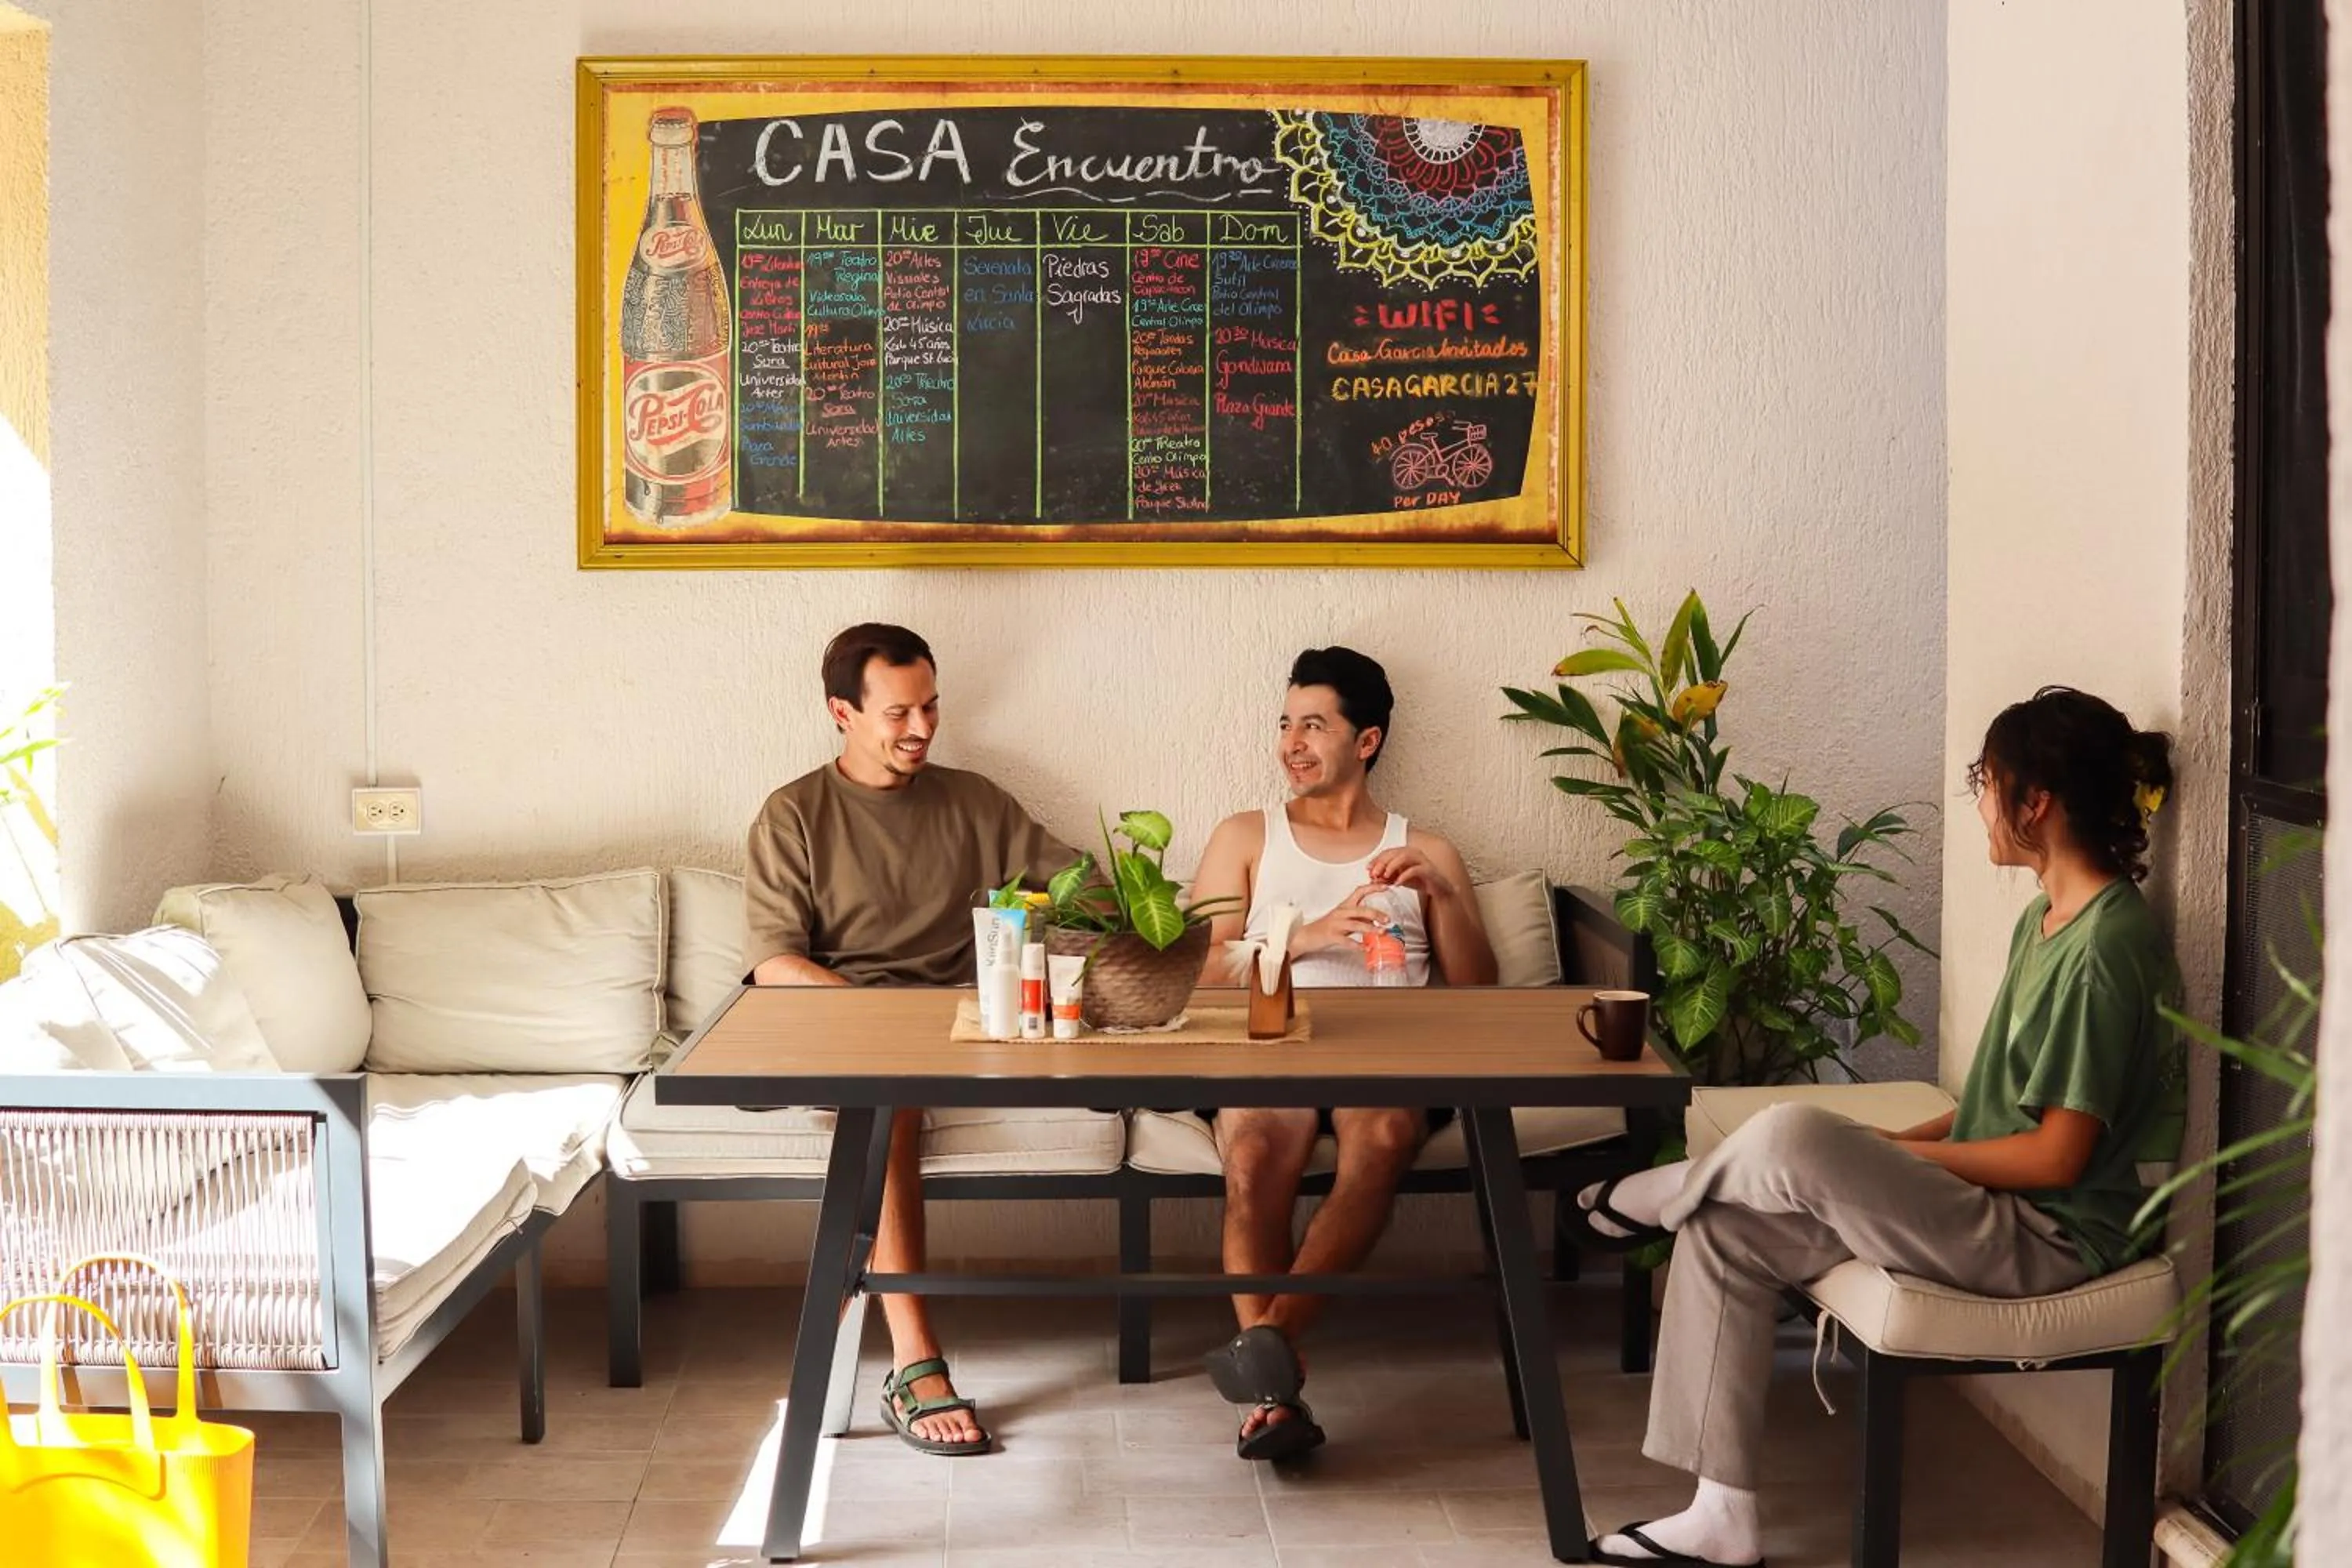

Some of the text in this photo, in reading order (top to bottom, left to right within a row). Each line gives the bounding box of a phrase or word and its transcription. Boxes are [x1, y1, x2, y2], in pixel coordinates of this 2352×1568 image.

[751, 118, 971, 187] CASA
[1006, 116, 1278, 188] Encuentro
[743, 214, 793, 242] Lun
[815, 215, 866, 242] Mar
[888, 216, 940, 242] Mie
[965, 214, 1022, 245] Jue
[1052, 212, 1109, 241] Vie
[1132, 214, 1185, 242] Sab
[1218, 213, 1289, 244] Dom
[840, 250, 877, 267] Teatro
[909, 250, 942, 269] Artes
[964, 255, 1033, 276] Serenata
[1042, 253, 1110, 278] Piedras
[1163, 249, 1201, 270] Cine
[884, 270, 941, 285] Visuales
[1167, 272, 1185, 285] de
[964, 281, 1034, 305] en Santa
[1047, 283, 1122, 325] Sagradas
[1377, 298, 1475, 332] WIFI
[909, 336, 927, 351] 45
[884, 351, 921, 371] Parque
[1425, 490, 1463, 505] DAY
